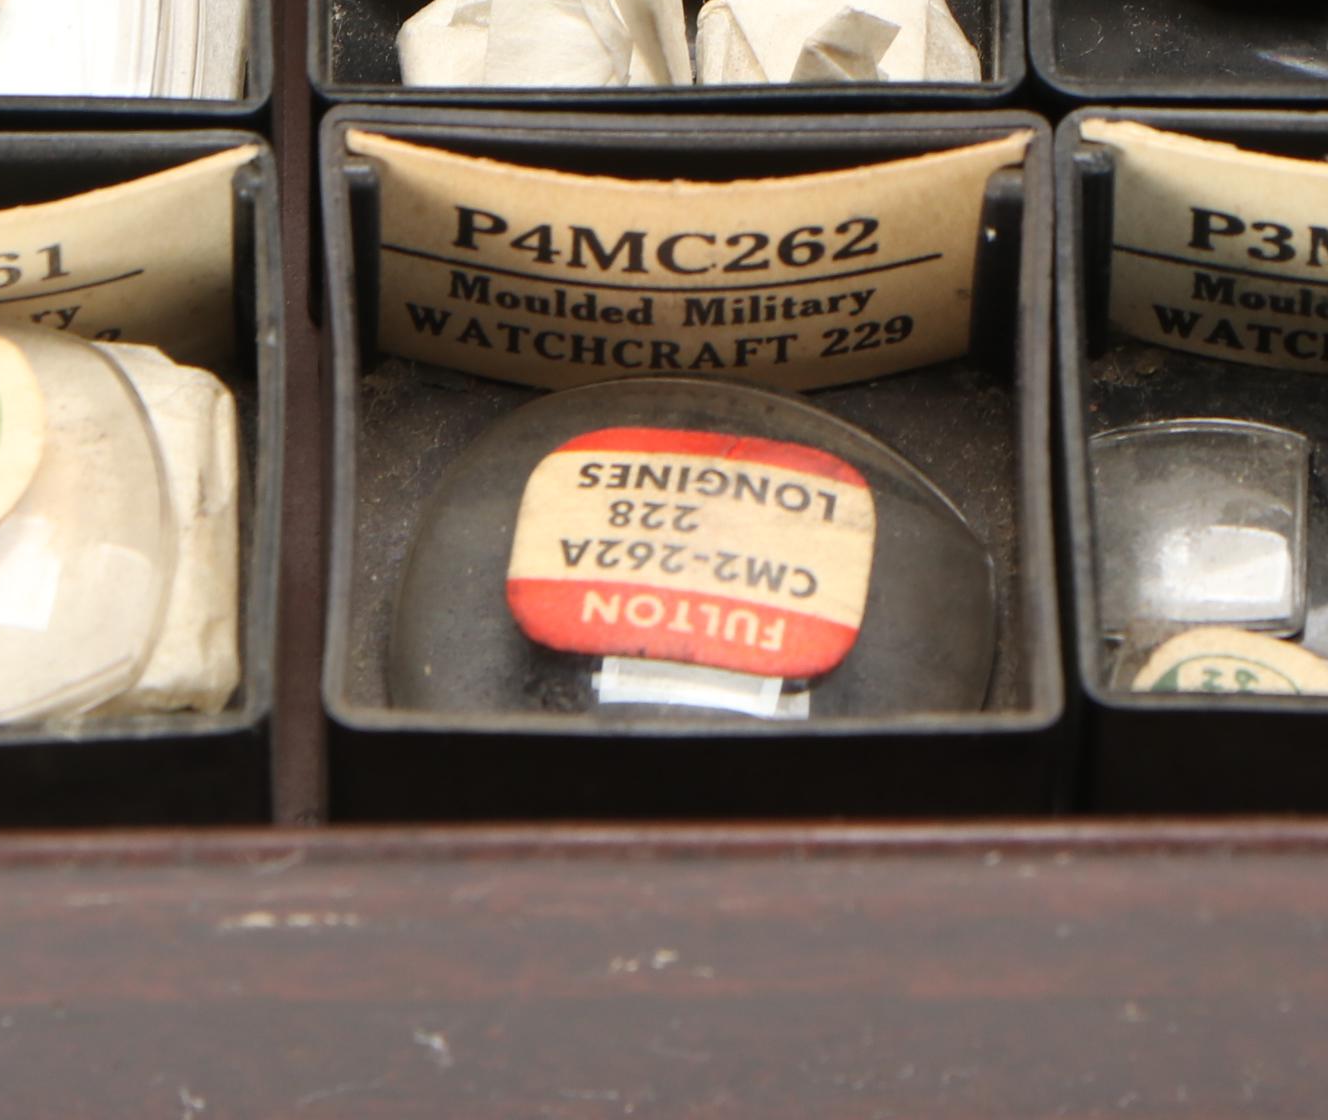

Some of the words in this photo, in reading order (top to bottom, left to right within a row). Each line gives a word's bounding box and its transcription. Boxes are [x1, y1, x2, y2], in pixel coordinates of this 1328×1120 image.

[452, 205, 881, 276] P4MC262
[450, 272, 654, 327] Moulded
[681, 288, 876, 329] Military
[404, 302, 796, 370] WATCHCRAFT
[821, 315, 914, 357] 229
[577, 461, 838, 523] LONGINES
[608, 500, 699, 531] 228
[559, 538, 818, 599] CM2-262A
[581, 591, 785, 652] FULTON
